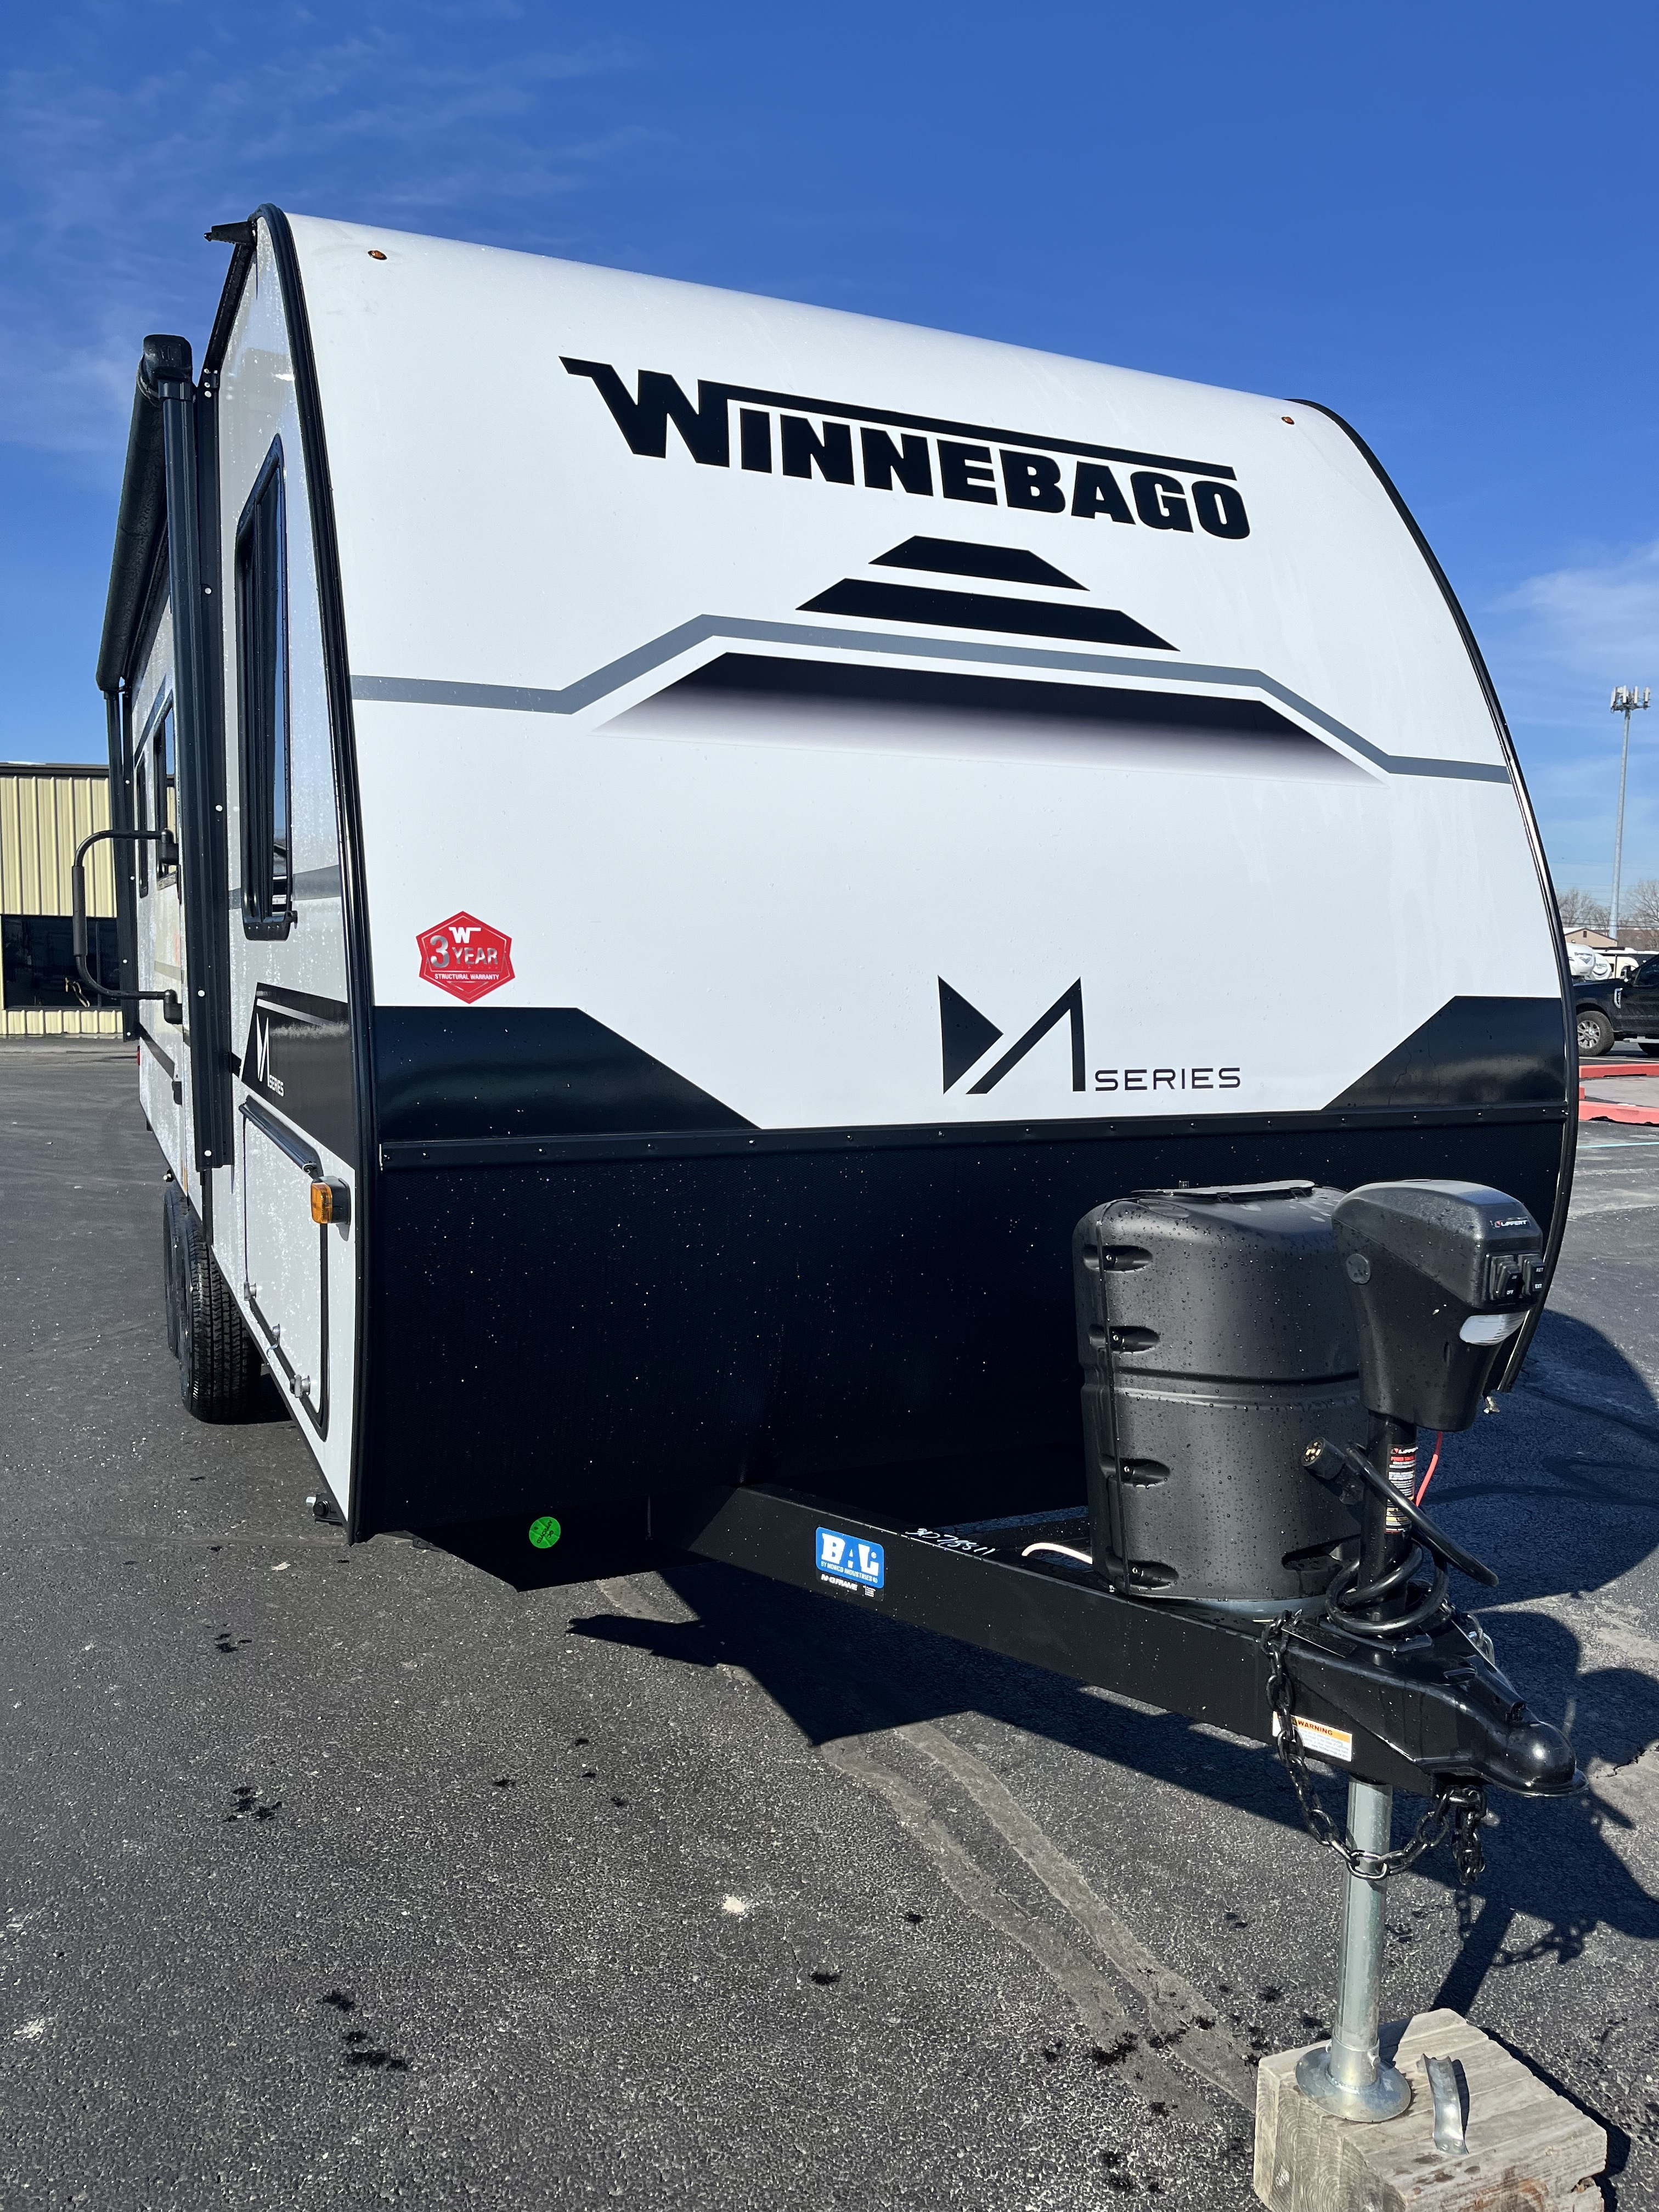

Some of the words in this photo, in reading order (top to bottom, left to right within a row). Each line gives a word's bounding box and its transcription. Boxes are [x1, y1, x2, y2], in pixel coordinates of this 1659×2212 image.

[558, 356, 1251, 540] WINNEBAGO
[430, 935, 450, 968] 3
[452, 947, 498, 965] YEAR
[1095, 1068, 1240, 1091] SERIES
[844, 1567, 873, 1582] INDUSTRIES
[1298, 1720, 1333, 1736] WARNING
